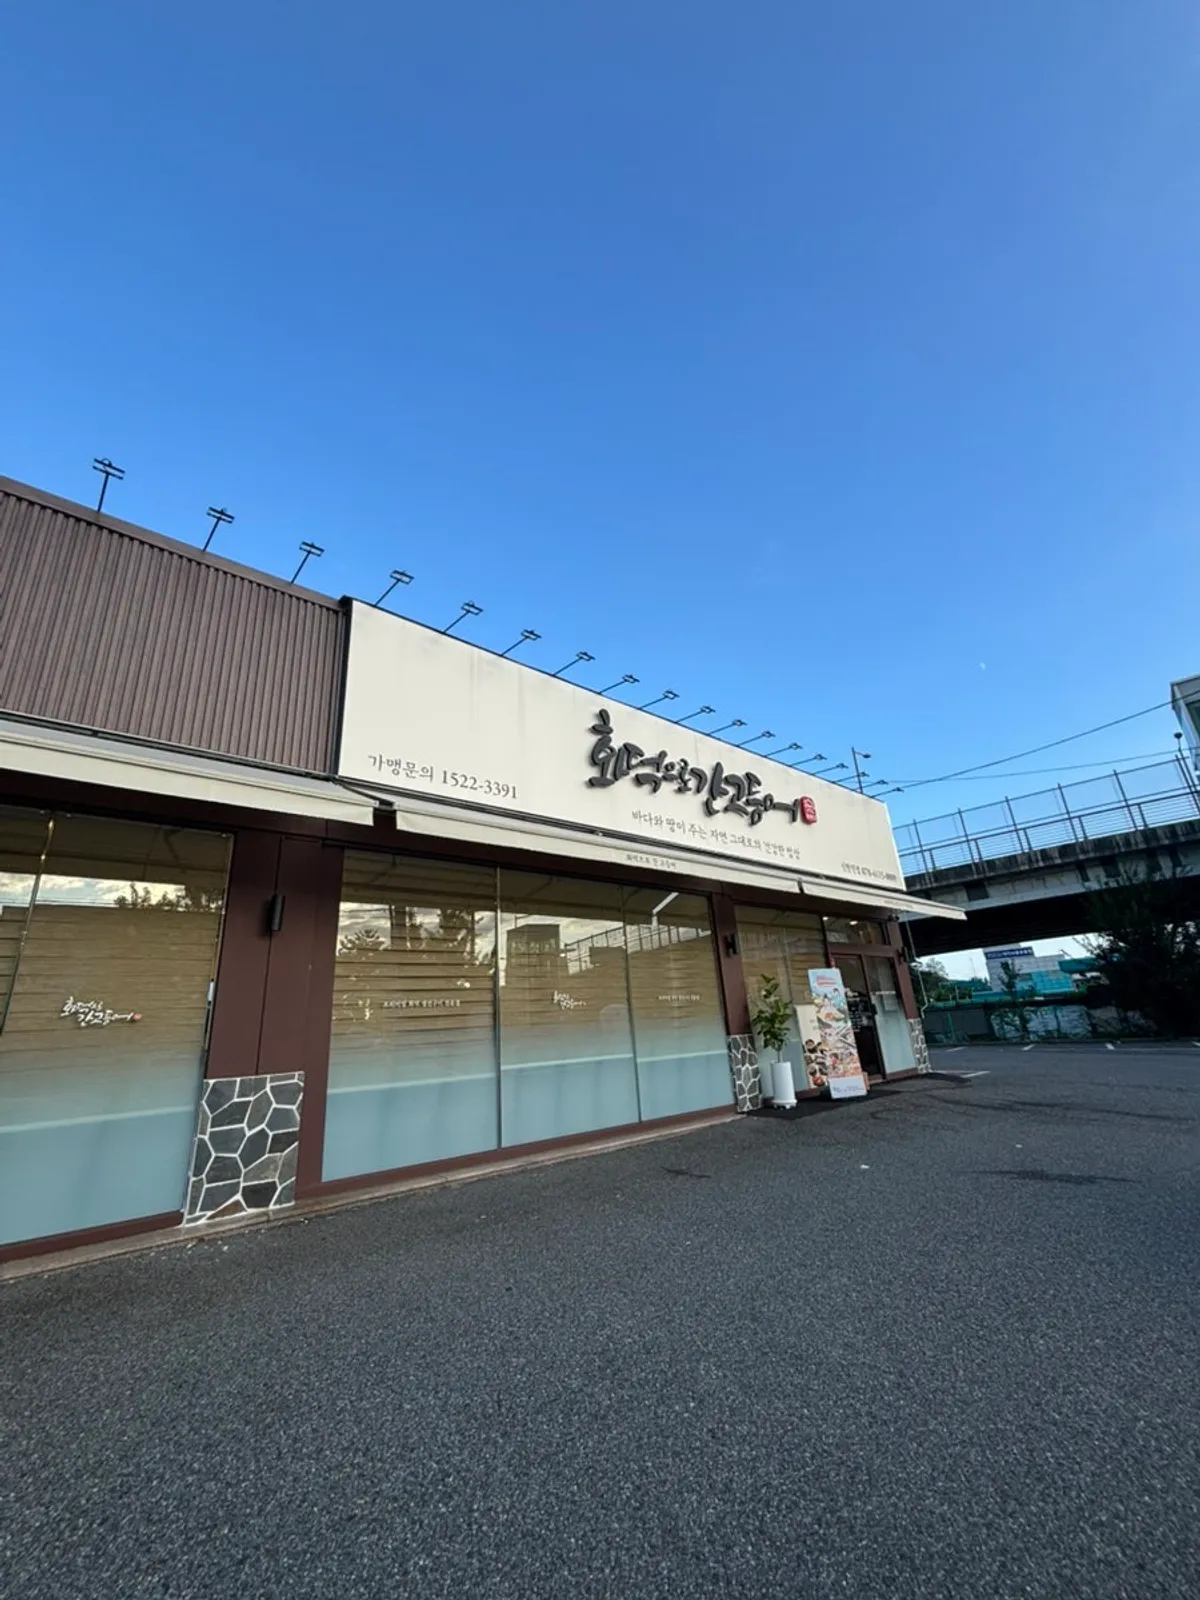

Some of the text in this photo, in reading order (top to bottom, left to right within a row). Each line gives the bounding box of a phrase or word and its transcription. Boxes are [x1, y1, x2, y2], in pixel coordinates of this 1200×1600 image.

[367, 754, 518, 799] 가맹문의 1522-3391
[632, 810, 663, 828] 바다와
[688, 823, 708, 840] 주는
[710, 828, 728, 844] 자연
